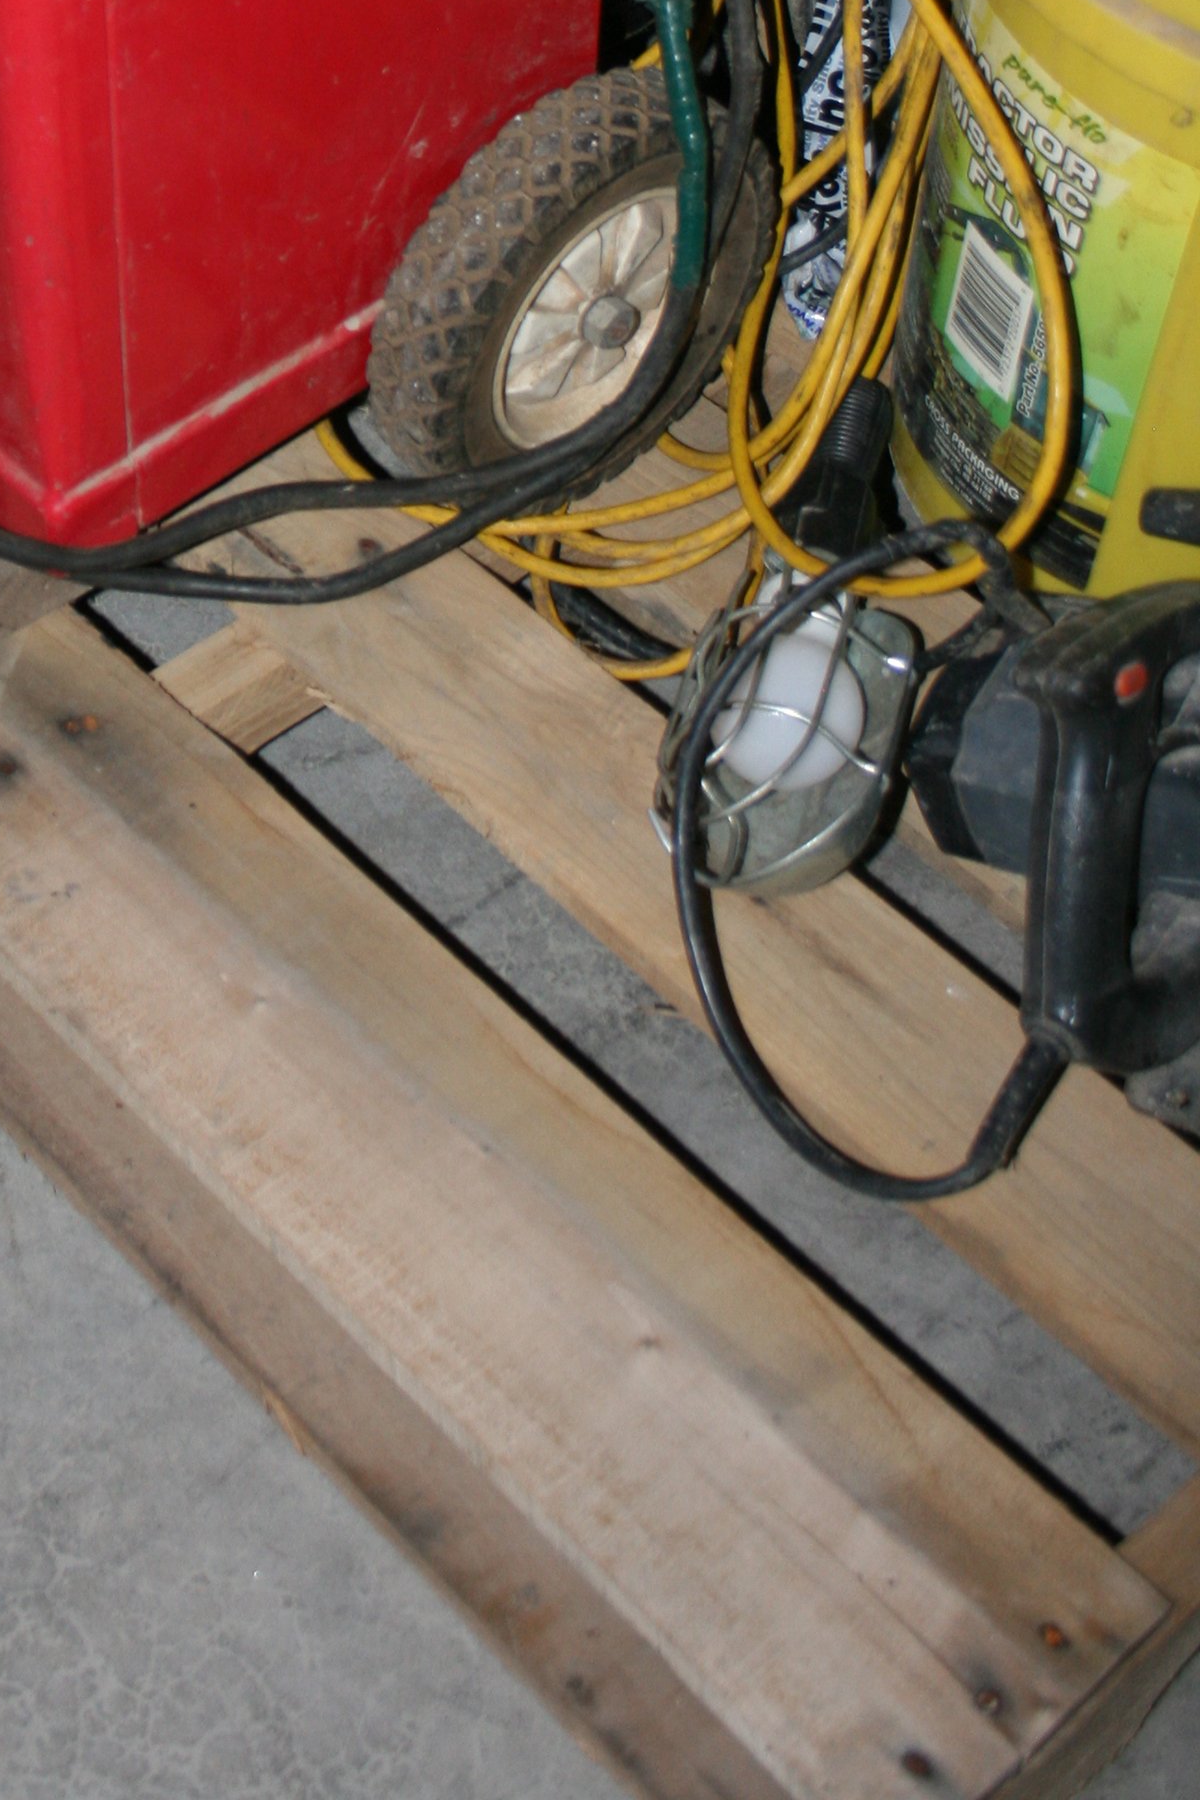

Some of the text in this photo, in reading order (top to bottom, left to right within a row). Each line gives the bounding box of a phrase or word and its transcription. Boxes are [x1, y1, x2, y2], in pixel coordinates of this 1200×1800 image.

[1016, 311, 1047, 418] Part No. 565
[924, 394, 950, 436] CROSS
[951, 432, 1020, 501] PACKAGING
